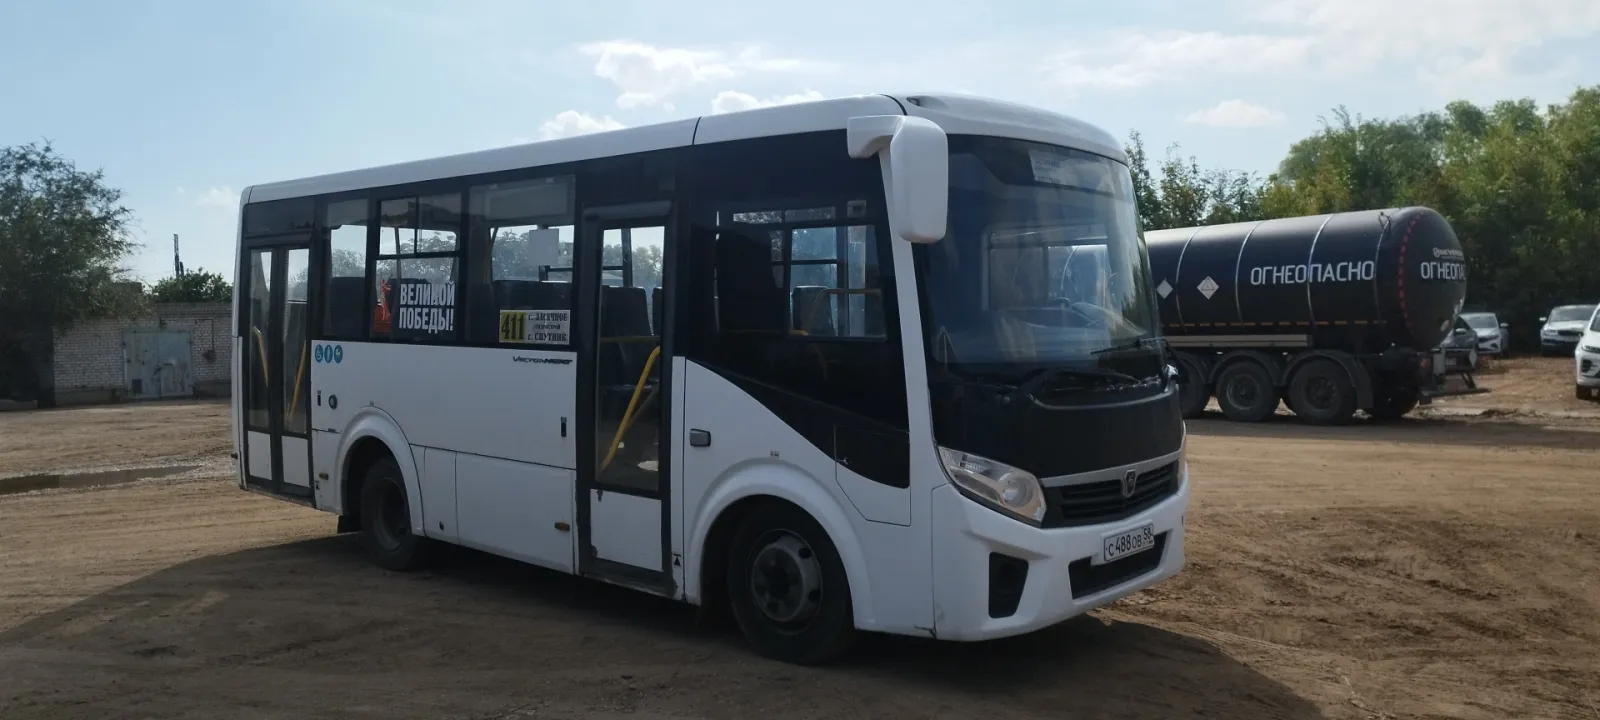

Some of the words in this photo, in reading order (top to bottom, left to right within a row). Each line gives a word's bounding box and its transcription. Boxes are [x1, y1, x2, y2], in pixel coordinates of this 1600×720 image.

[1250, 260, 1375, 285] ОГНЕОПАСНО
[400, 282, 455, 305] ВЕЛИКОЙ
[399, 307, 454, 333] ПОБЕДЫ!
[501, 313, 525, 340] 411
